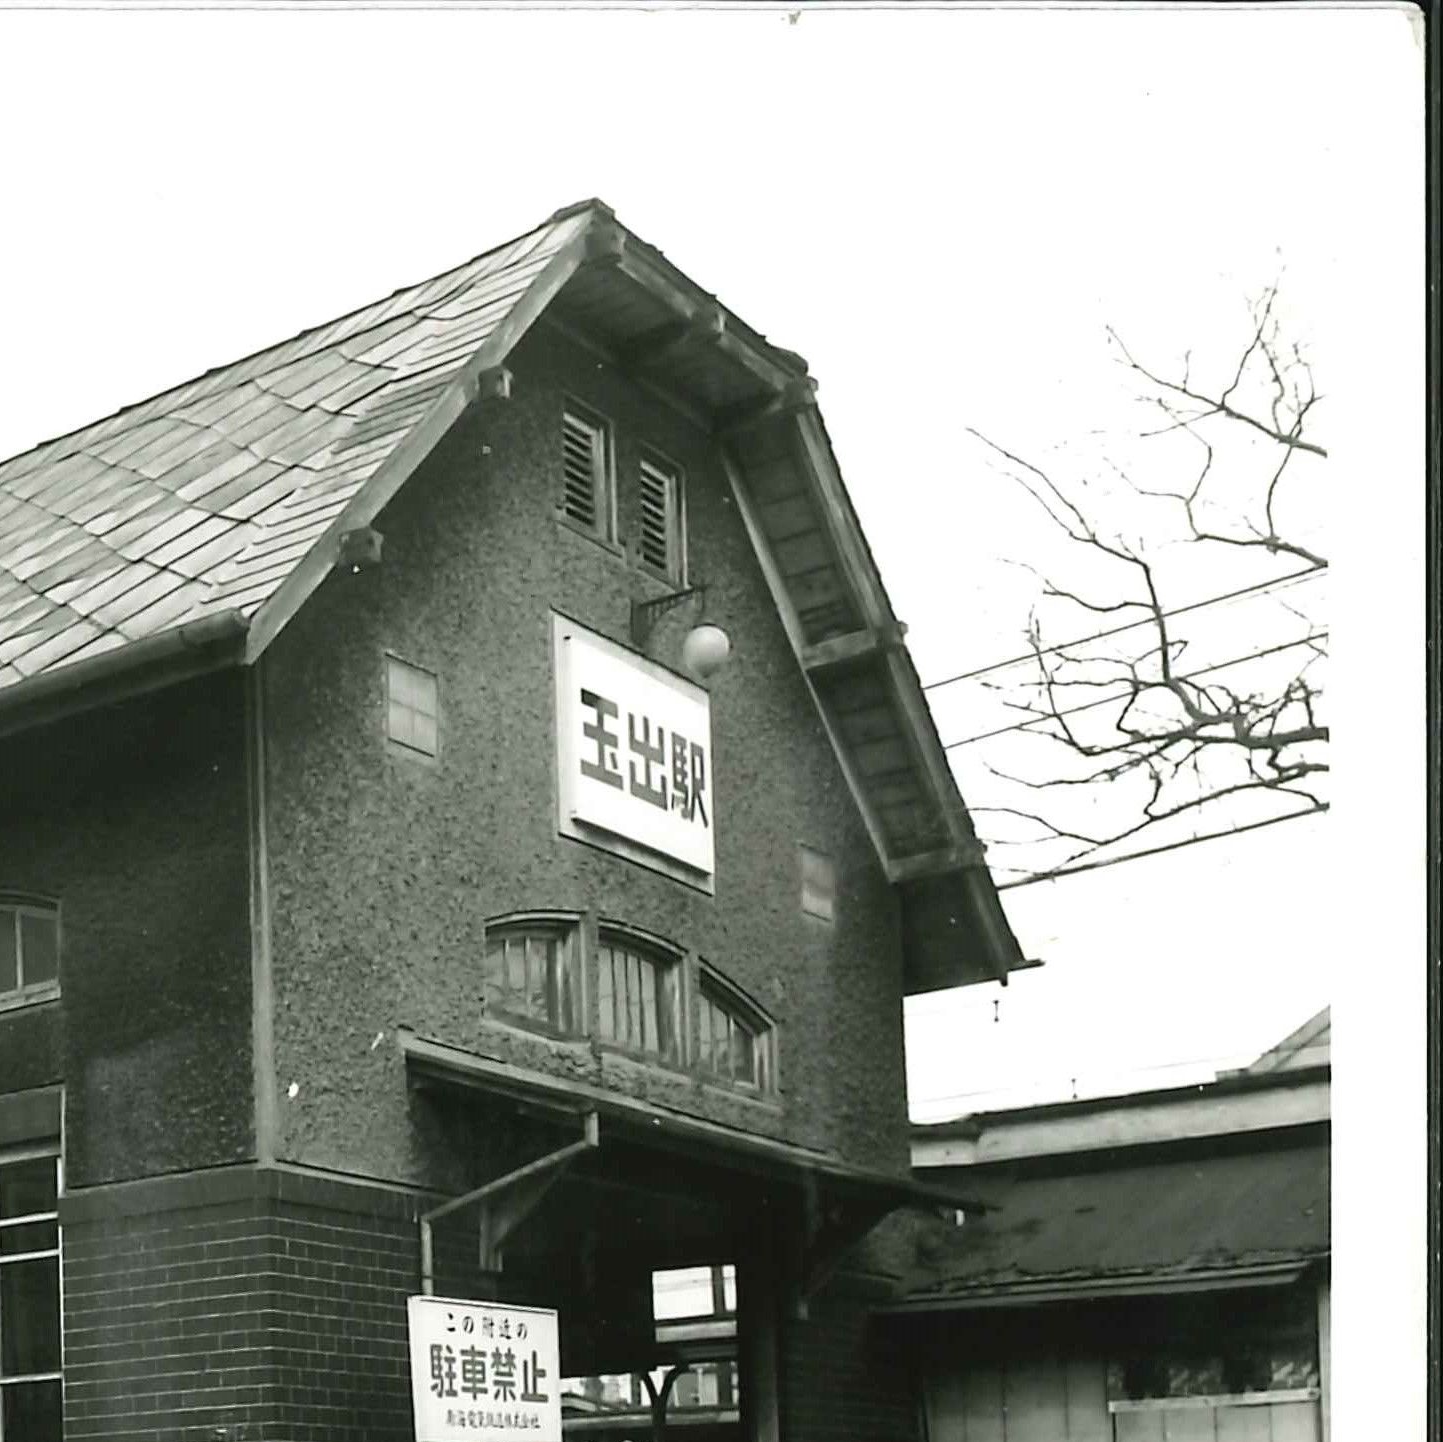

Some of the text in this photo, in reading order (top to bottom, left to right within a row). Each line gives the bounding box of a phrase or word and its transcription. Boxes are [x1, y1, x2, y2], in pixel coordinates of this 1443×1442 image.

[580, 687, 708, 828] 玉出駅
[430, 1343, 549, 1403] 駐車禁止
